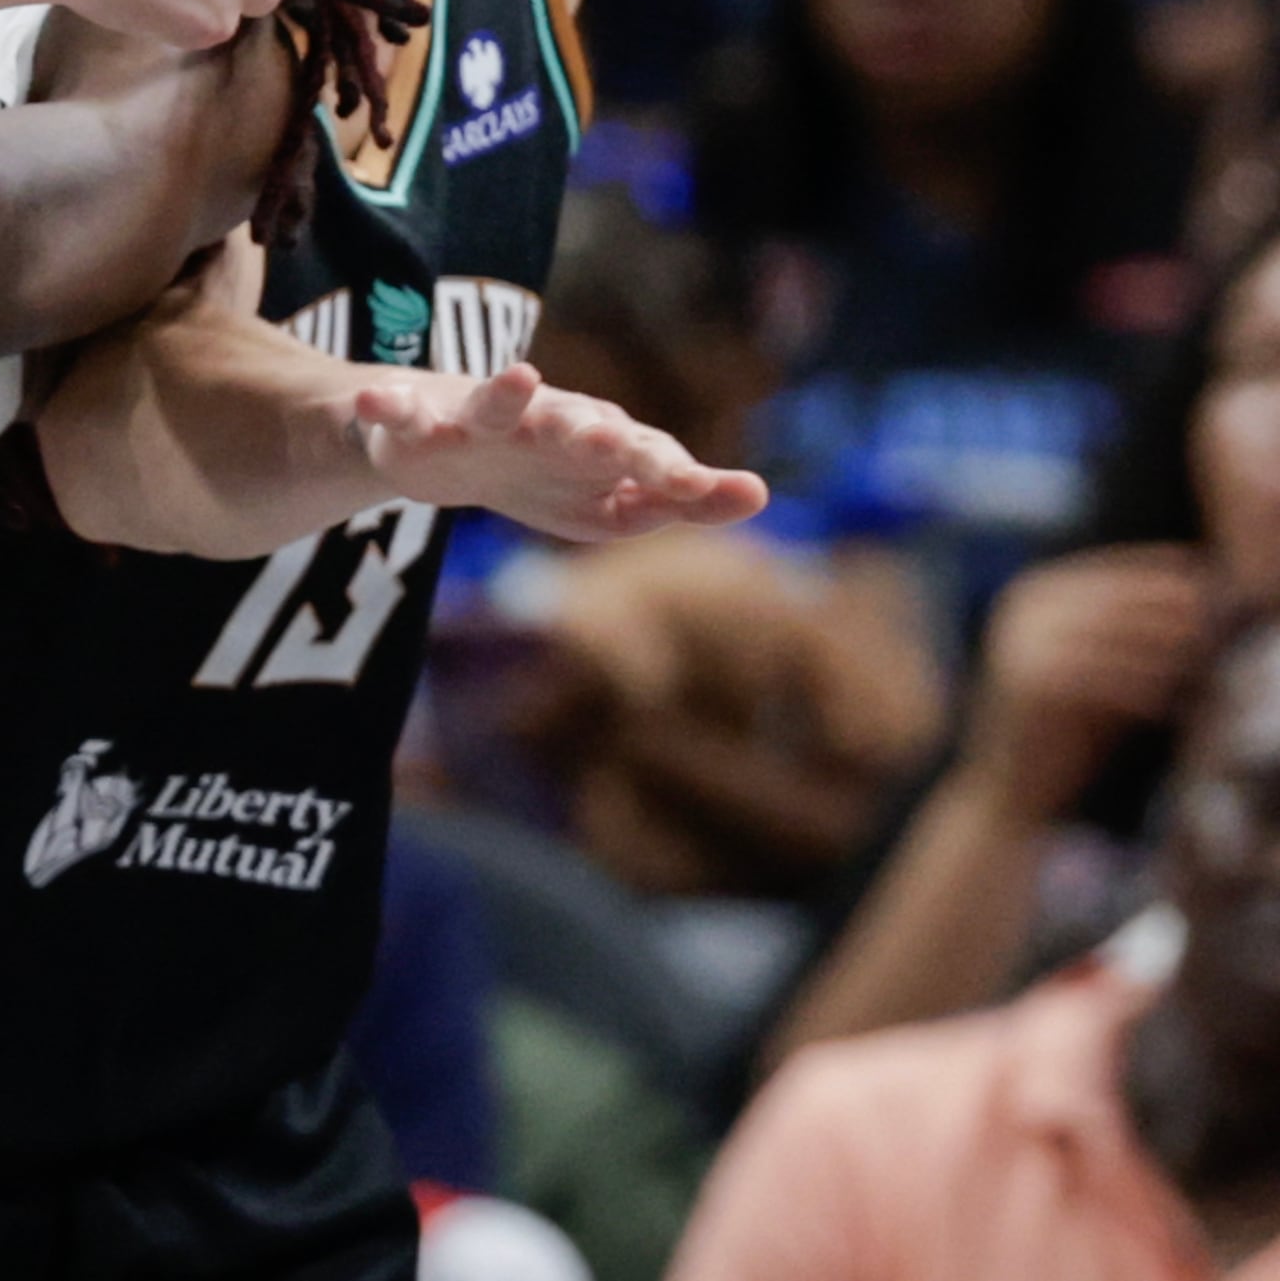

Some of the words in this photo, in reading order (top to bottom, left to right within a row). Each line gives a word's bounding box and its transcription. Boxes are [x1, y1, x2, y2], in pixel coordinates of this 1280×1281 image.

[190, 496, 438, 689] 13
[146, 772, 352, 848] Liberty
[115, 822, 335, 891] Mutual
